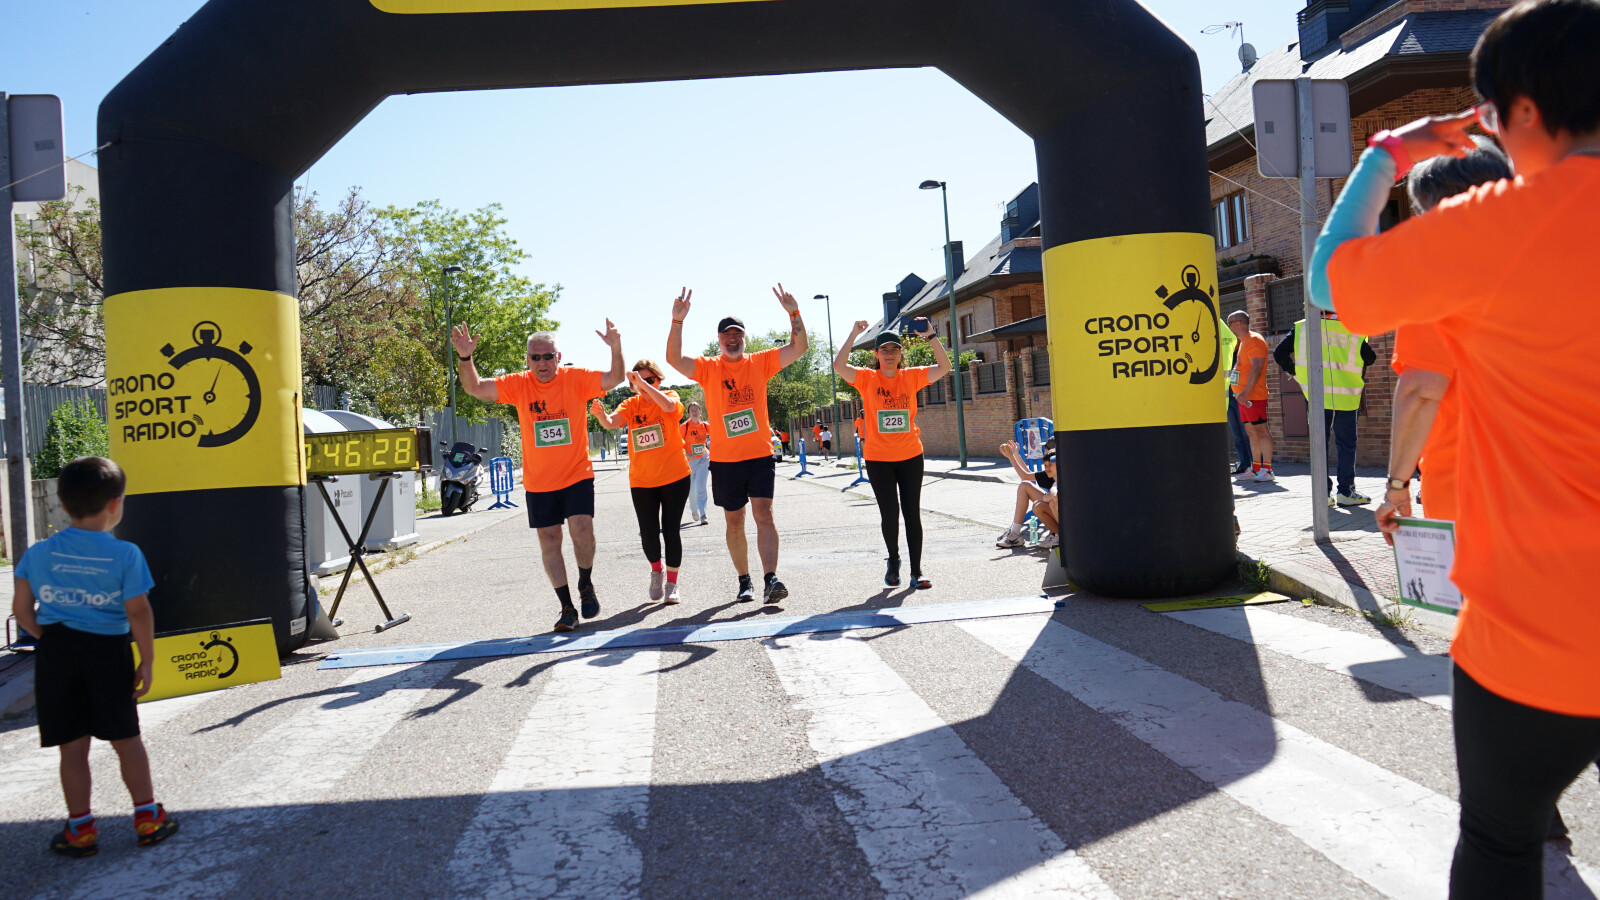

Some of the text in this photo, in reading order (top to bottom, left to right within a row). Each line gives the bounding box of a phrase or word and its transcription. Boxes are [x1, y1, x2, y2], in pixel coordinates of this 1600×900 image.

[1084, 312, 1170, 334] CRONO
[1098, 335, 1184, 357] SPORT
[1112, 358, 1188, 379] RADIO
[109, 372, 175, 397] CRONO
[115, 395, 192, 420] SPORT
[731, 417, 750, 430] 206
[885, 417, 903, 426] 228
[123, 420, 197, 443] RADIO
[542, 427, 563, 439] 354
[638, 432, 656, 444] 201
[171, 651, 207, 663] CRONO
[178, 659, 214, 672] SPORT
[185, 668, 217, 680] RADIO
